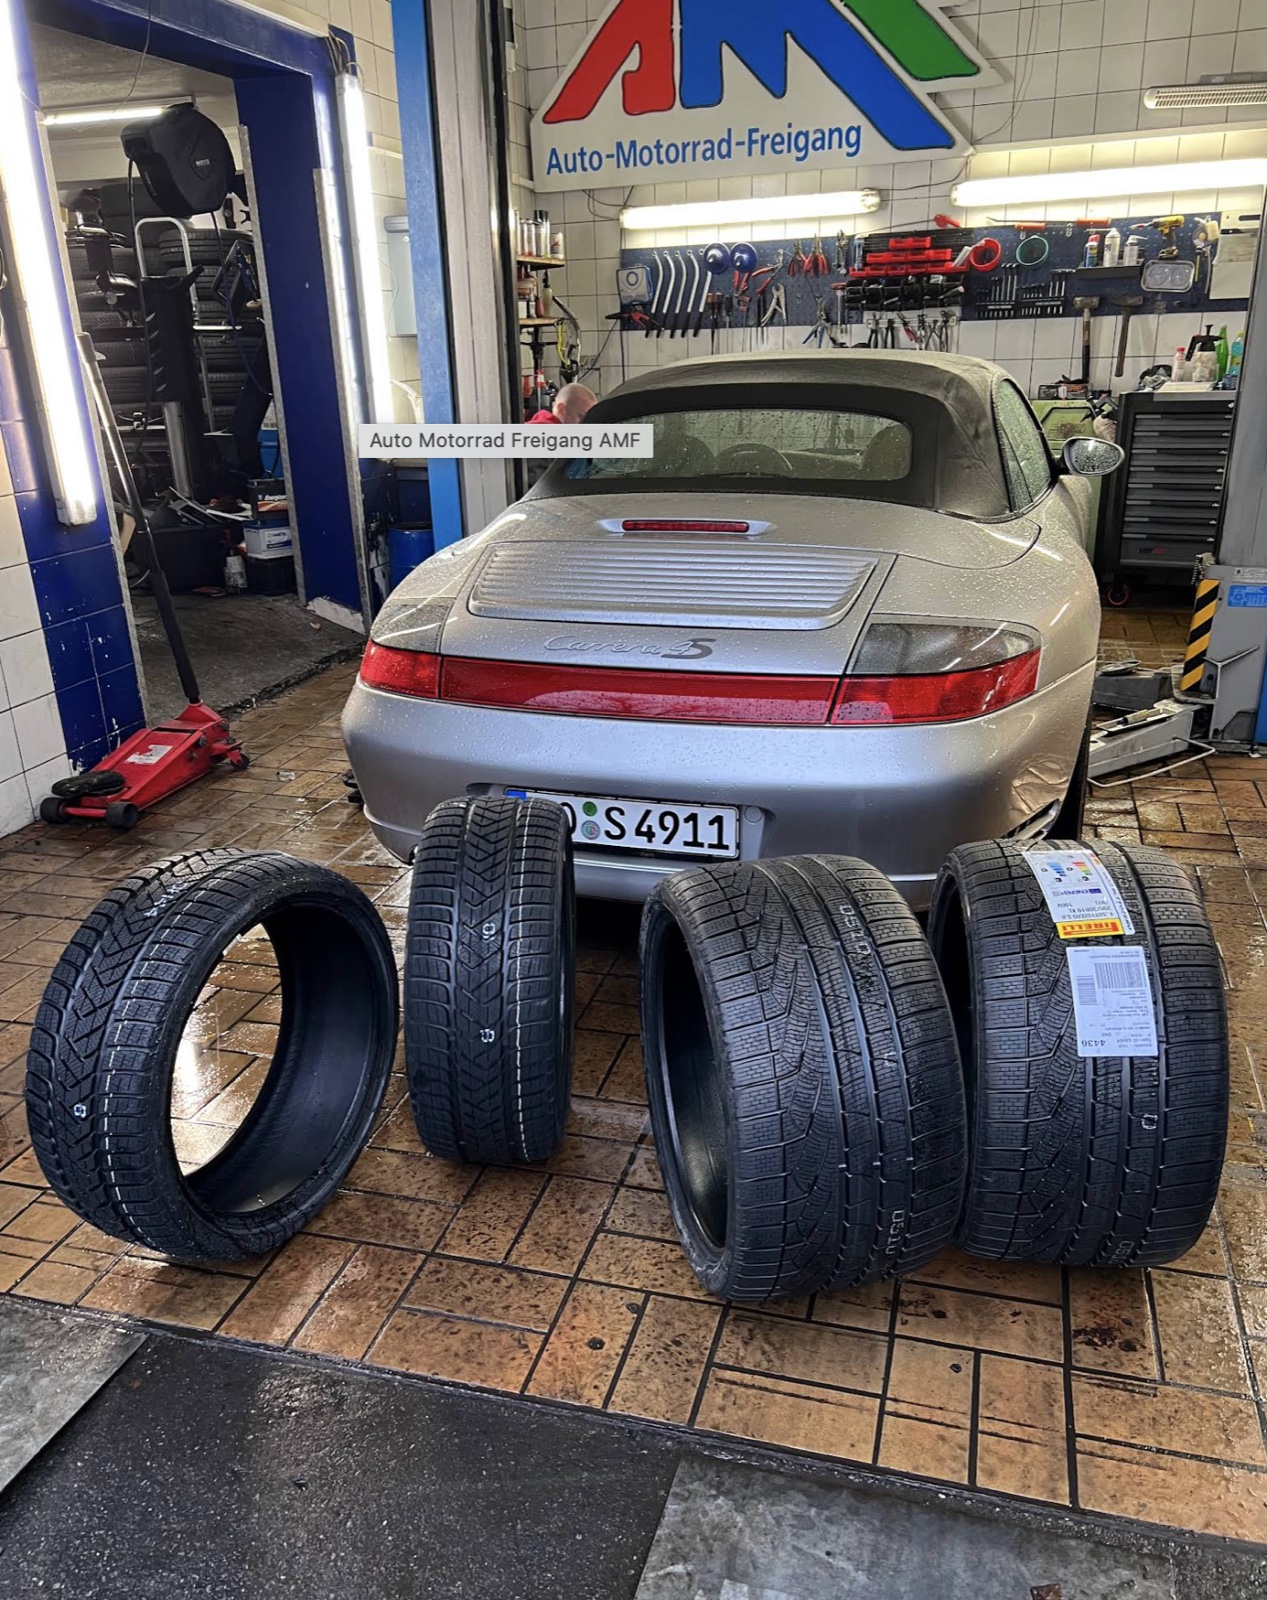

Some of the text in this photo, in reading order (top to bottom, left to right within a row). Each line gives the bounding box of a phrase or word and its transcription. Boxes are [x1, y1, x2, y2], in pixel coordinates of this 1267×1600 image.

[545, 123, 863, 175] Auto-Motorrad-Freigang
[543, 634, 717, 659] Carrera 4S
[1061, 921, 1120, 937] PIRELLI
[1081, 1039, 1107, 1048] 4436
